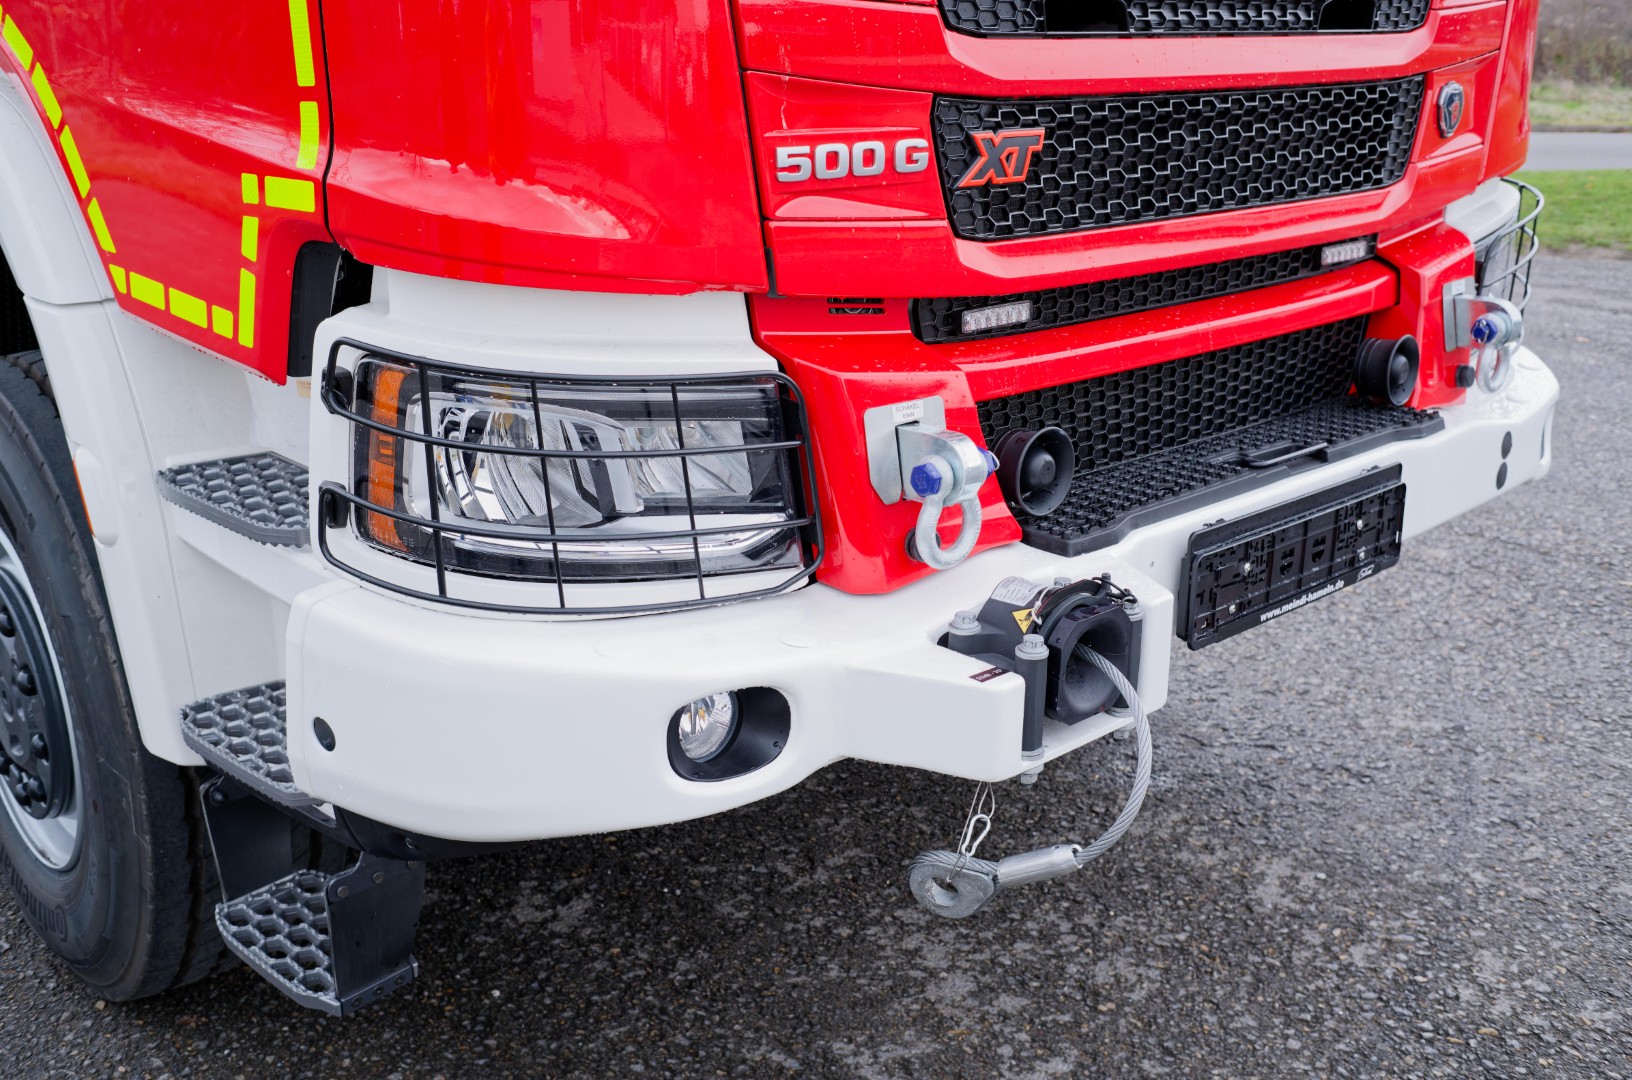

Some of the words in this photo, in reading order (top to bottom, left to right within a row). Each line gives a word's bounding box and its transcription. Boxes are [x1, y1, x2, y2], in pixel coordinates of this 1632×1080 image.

[776, 140, 885, 182] 500
[894, 138, 929, 174] G
[954, 127, 1045, 189] XT
[1260, 580, 1345, 622] www.meindl-hameln.de
